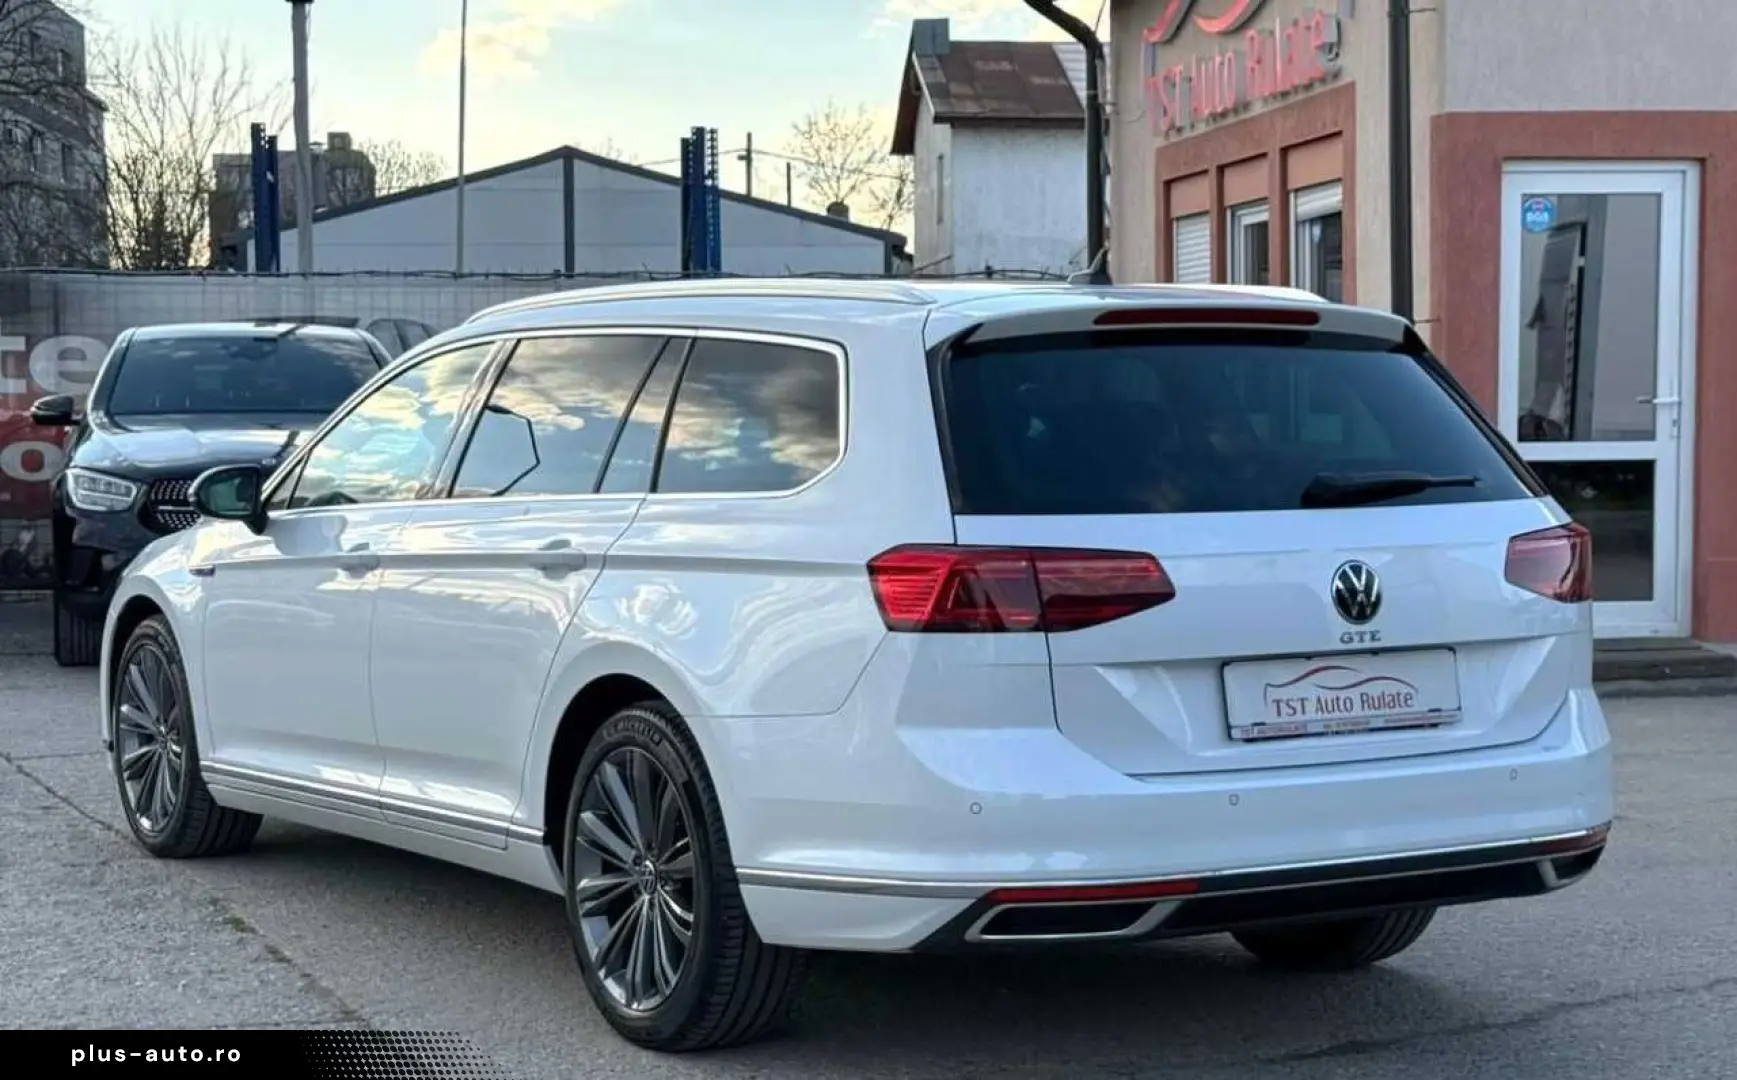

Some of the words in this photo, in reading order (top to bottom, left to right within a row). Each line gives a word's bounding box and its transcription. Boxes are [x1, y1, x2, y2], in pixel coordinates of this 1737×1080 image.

[1339, 630, 1382, 645] GTE
[1272, 697, 1309, 718] TST
[1315, 693, 1354, 716] Auto
[1360, 690, 1414, 713] Rulate
